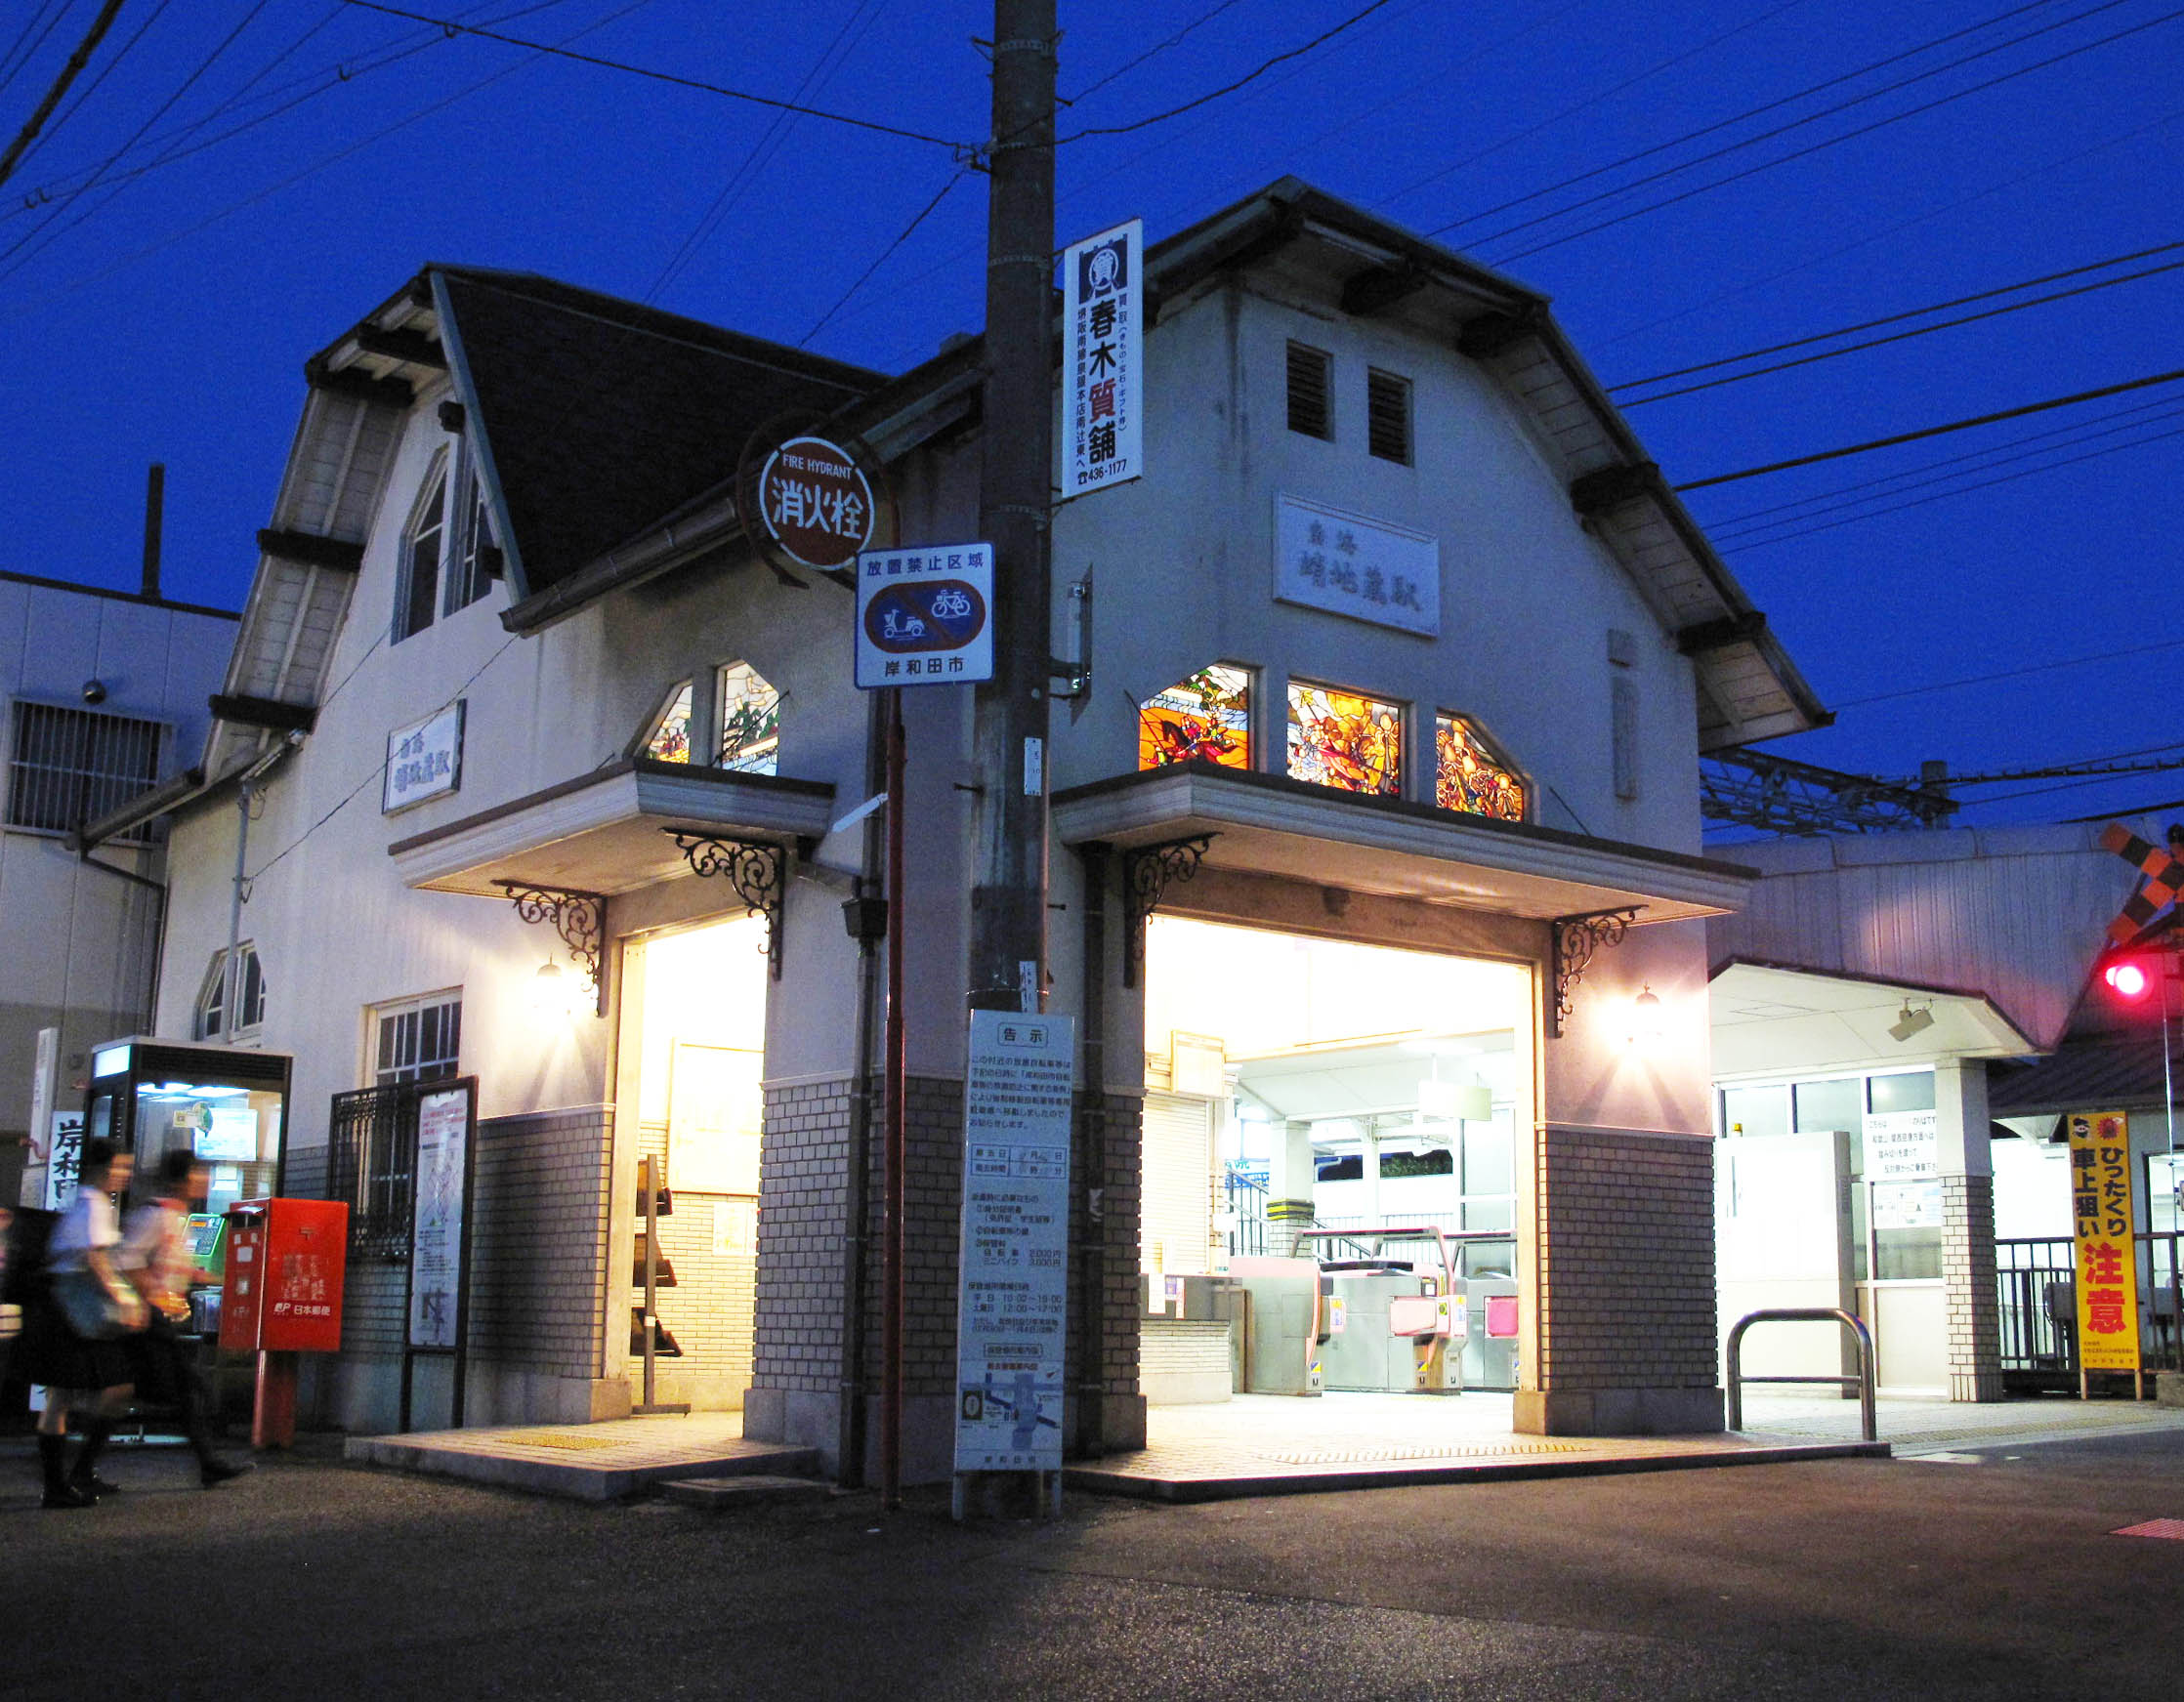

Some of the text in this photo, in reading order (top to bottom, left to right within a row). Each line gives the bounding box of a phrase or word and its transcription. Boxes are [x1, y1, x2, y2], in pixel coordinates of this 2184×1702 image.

[1088, 297, 1117, 466] 春木質舗
[782, 453, 853, 481] FIRE HYDRANT
[772, 476, 864, 540] 消火栓
[866, 551, 985, 577] 放置禁止区域
[884, 655, 964, 678] 岸和田市
[1003, 1027, 1043, 1043] 告示
[2072, 1145, 2101, 1239] 車上狙い
[2099, 1144, 2128, 1238] ひったくり
[293, 1304, 331, 1317] 日本郵便
[2081, 1239, 2127, 1336] 注意
